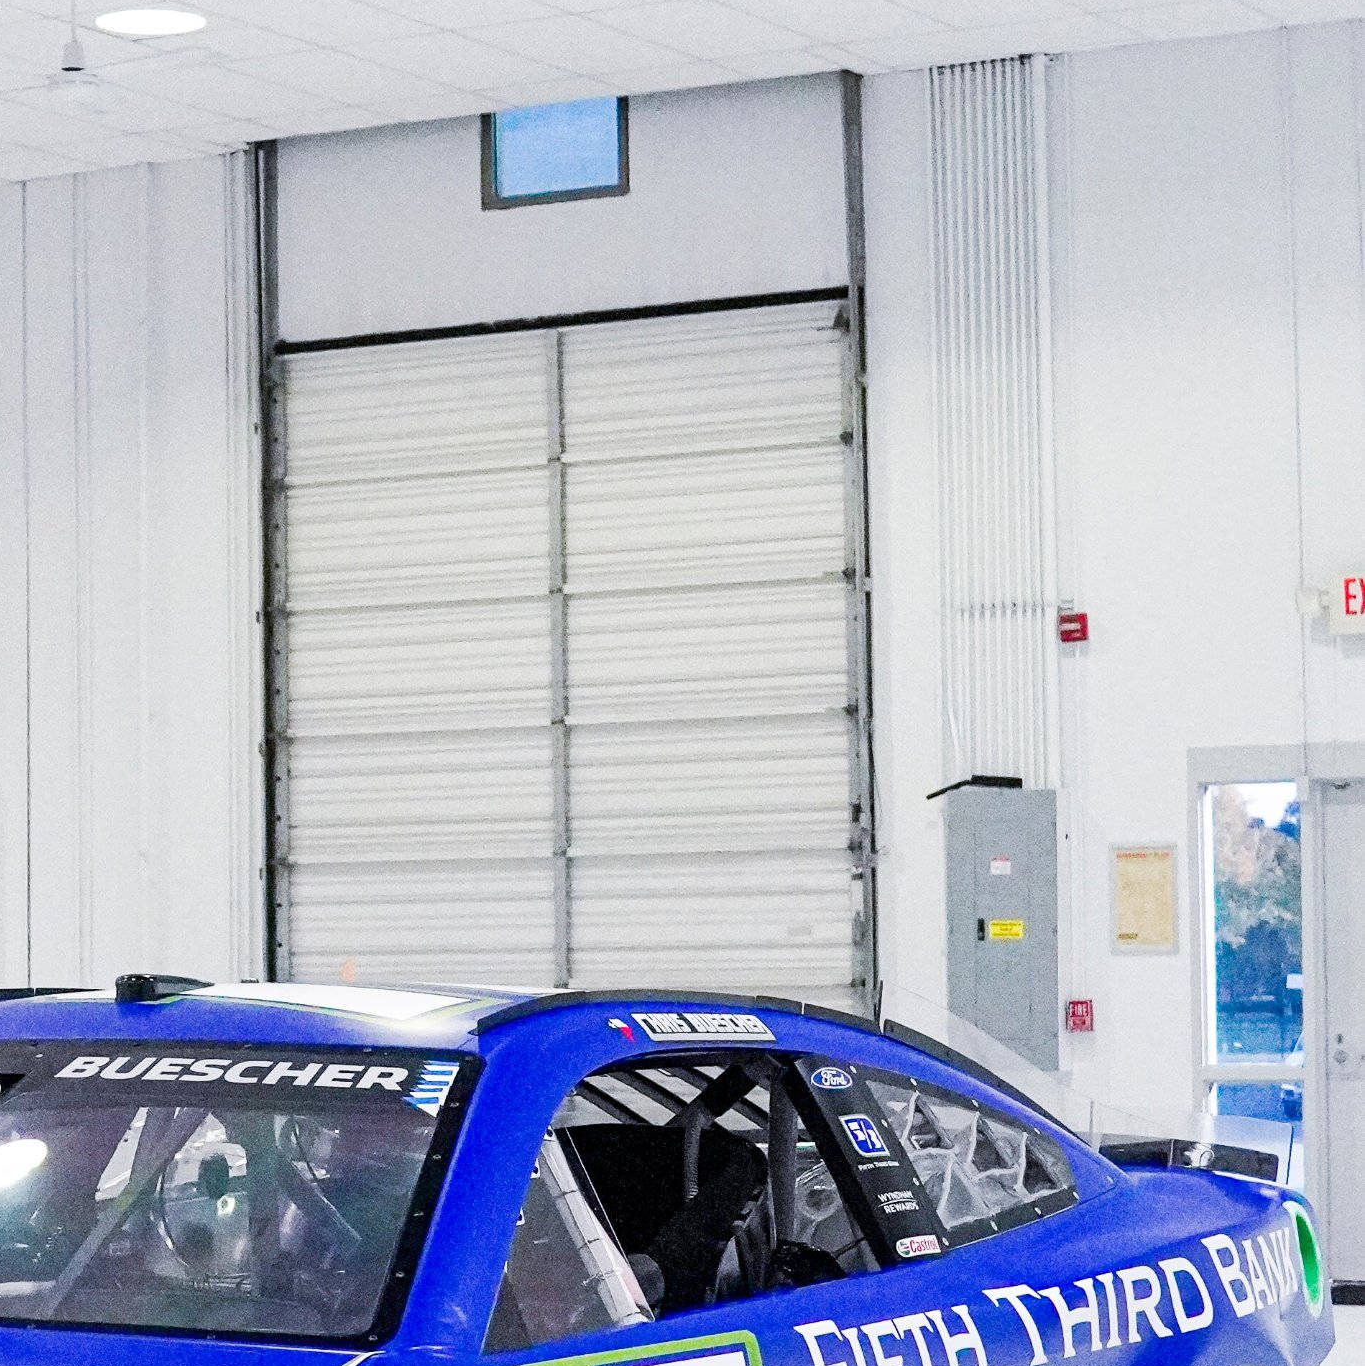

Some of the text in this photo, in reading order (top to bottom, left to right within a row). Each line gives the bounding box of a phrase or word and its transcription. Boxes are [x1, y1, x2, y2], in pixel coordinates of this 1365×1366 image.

[54, 1056, 409, 1091] BUESCHER
[981, 1256, 1214, 1366] THIRD
[1201, 1227, 1299, 1318] BANK
